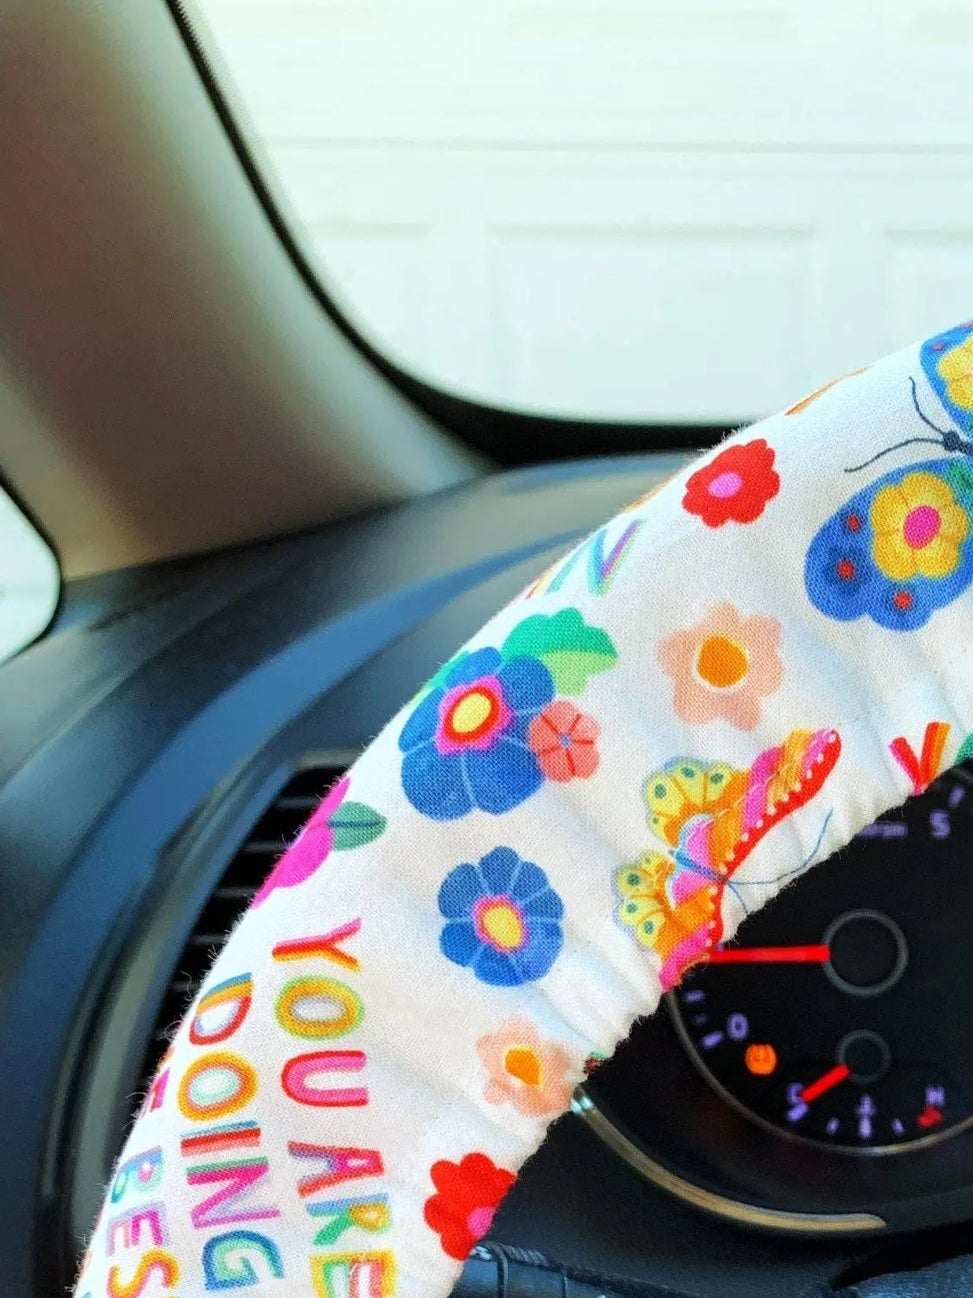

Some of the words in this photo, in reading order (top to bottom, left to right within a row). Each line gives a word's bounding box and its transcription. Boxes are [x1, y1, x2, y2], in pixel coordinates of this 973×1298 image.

[929, 810, 951, 839] 5
[272, 917, 369, 1108] YOU
[726, 1012, 749, 1041] 0
[177, 972, 286, 1292] DOING
